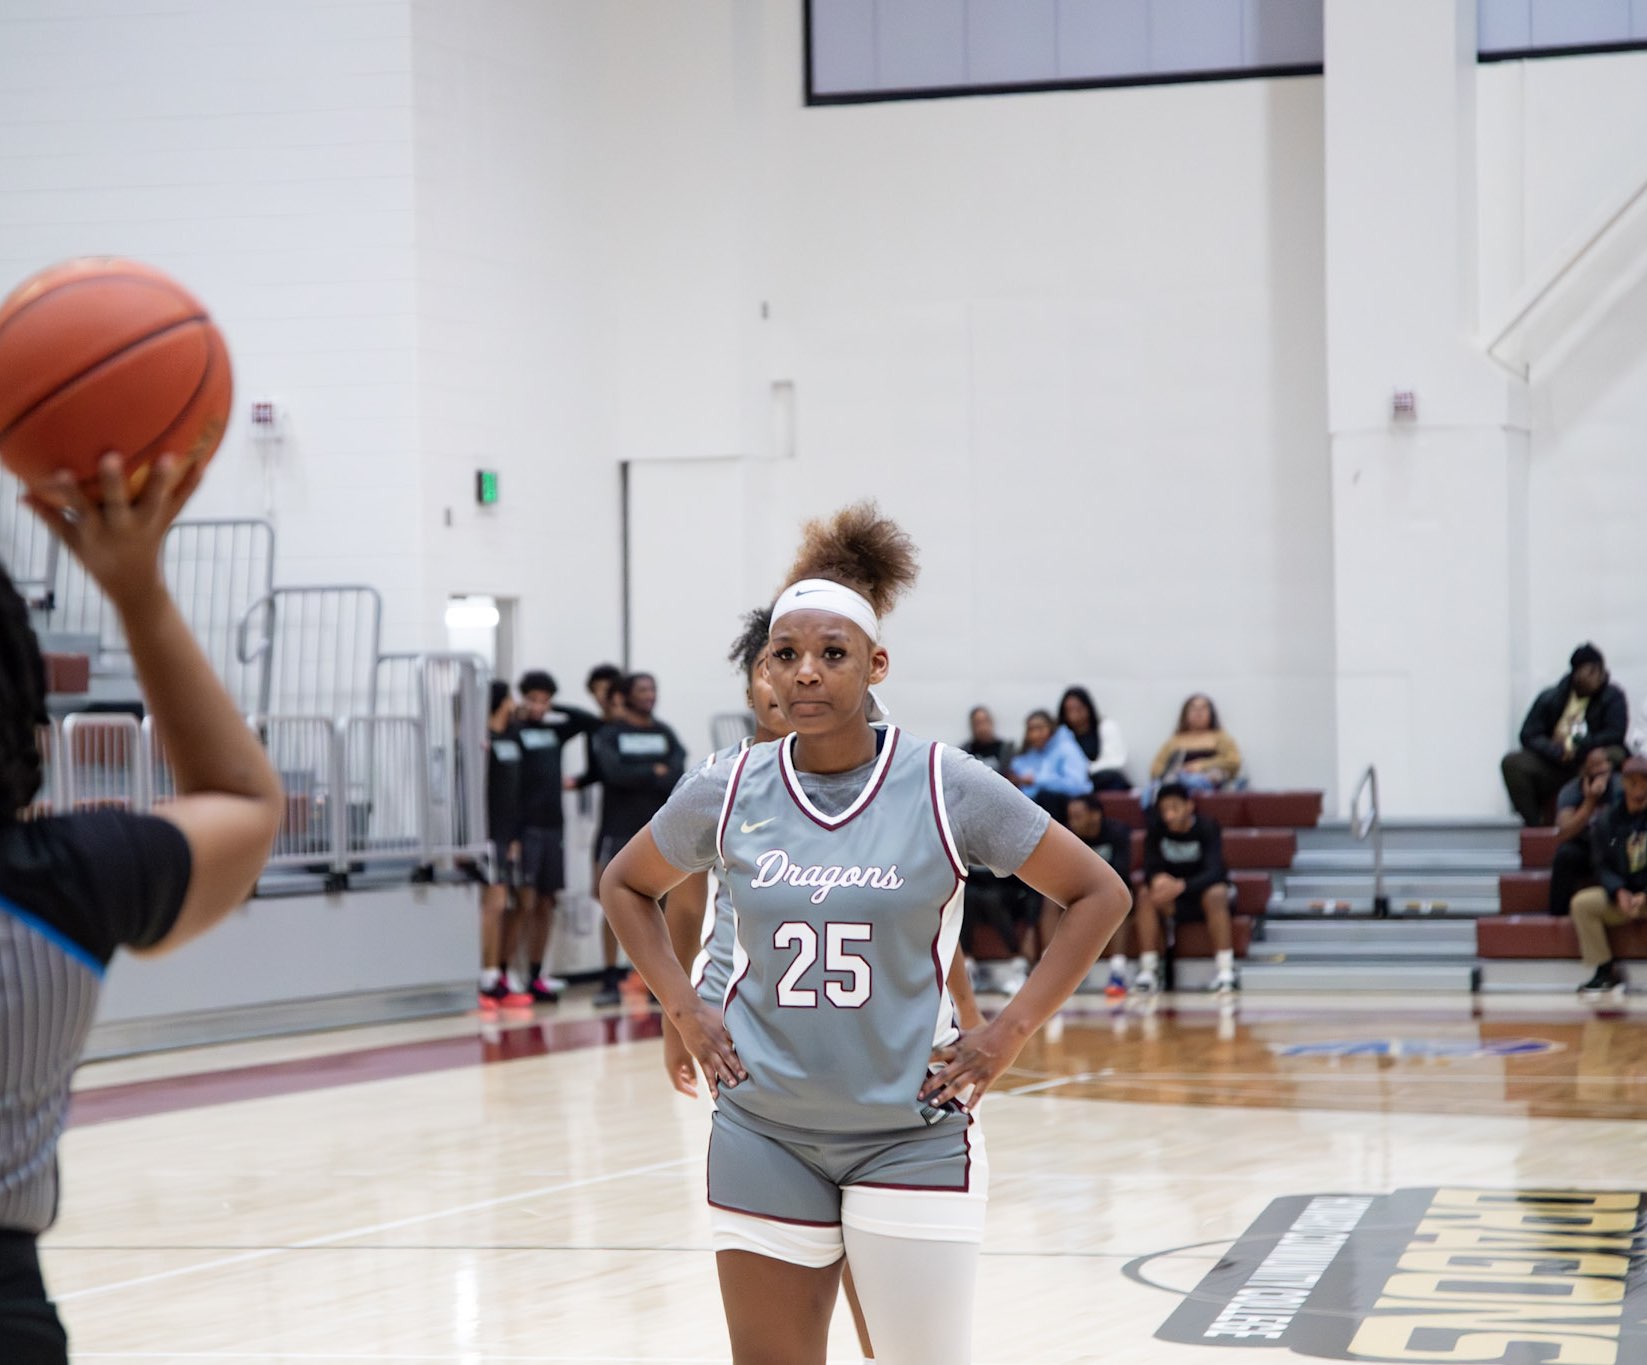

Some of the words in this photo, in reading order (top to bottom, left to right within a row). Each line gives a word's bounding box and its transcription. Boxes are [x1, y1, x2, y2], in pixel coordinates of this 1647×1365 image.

[751, 849, 904, 904] Dragons
[773, 921, 873, 1008] 25
[1347, 1188, 1641, 1365] DRAGONS
[1202, 1287, 1313, 1339] COLLEGE
